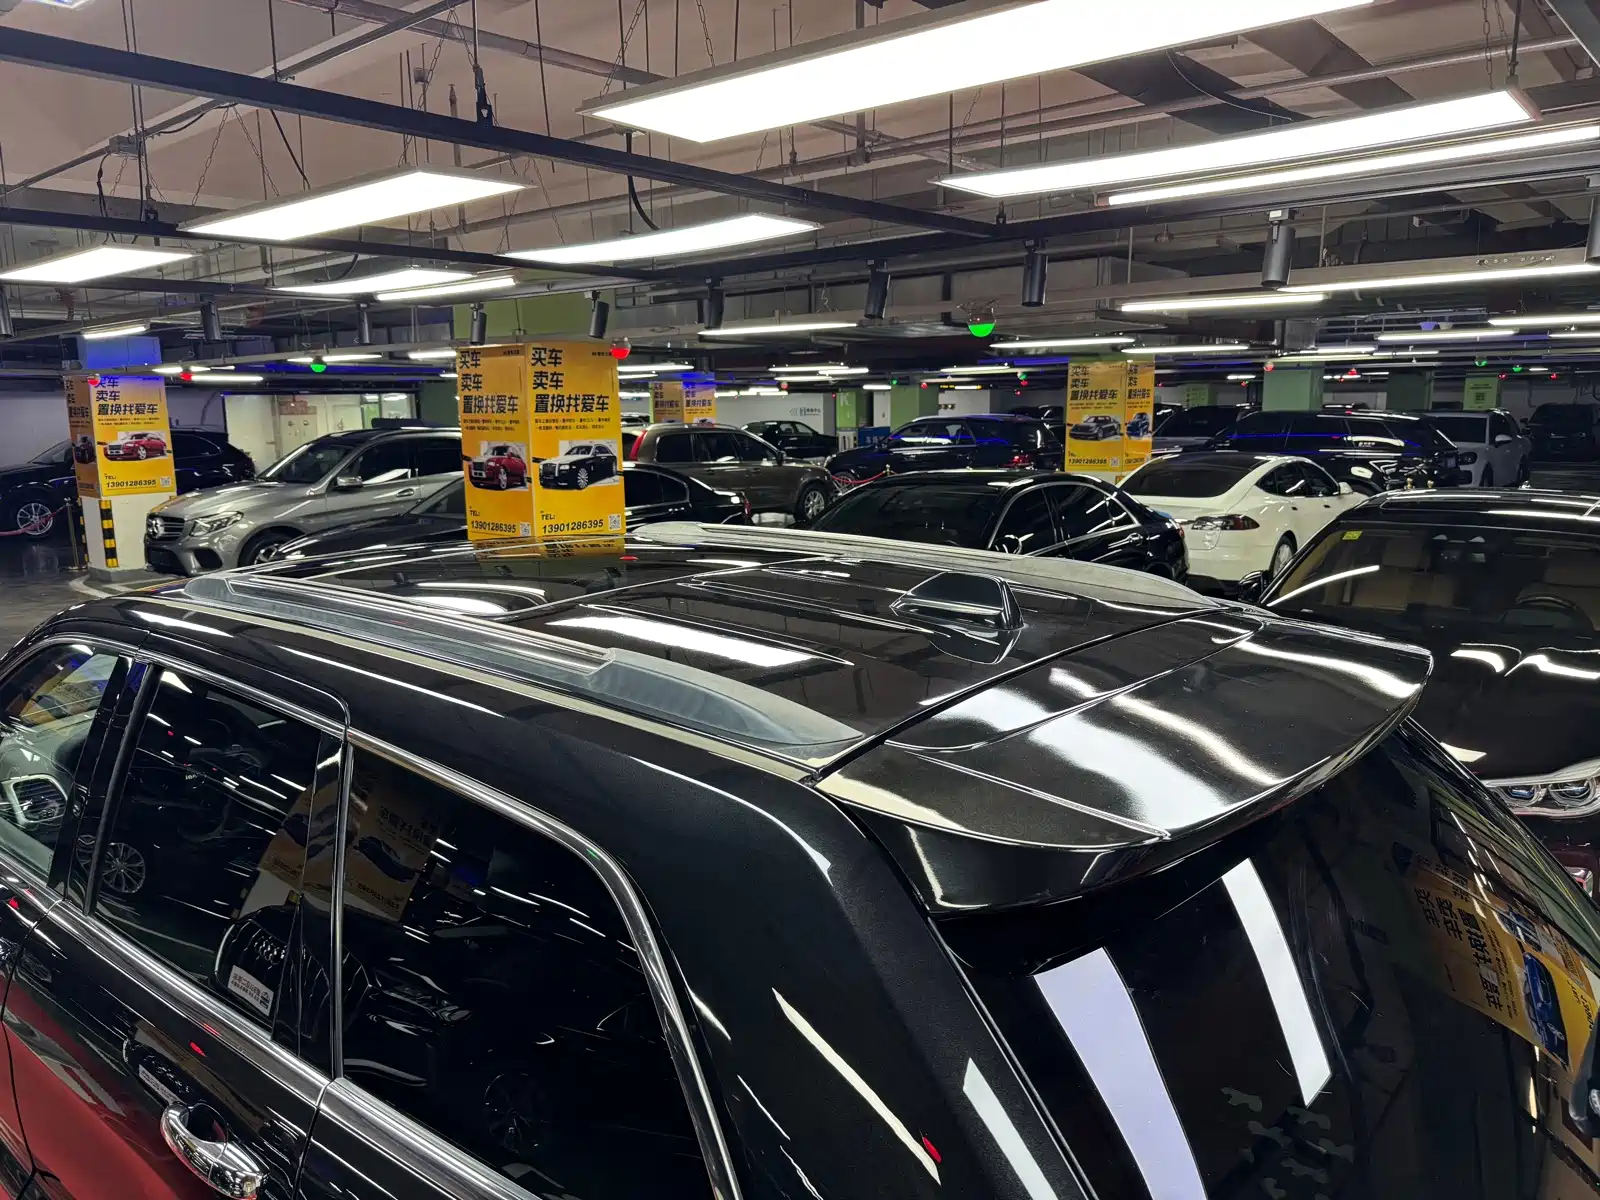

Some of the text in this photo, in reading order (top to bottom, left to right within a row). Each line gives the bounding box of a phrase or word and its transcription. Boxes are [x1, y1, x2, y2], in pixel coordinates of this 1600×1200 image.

[459, 350, 481, 369] 买车
[531, 347, 563, 367] 买车
[461, 373, 482, 392] 卖车
[532, 371, 564, 390] 卖车
[96, 390, 120, 402] 卖车
[463, 395, 519, 414] 置换找爱车
[534, 393, 610, 413] 置换找爱车
[97, 403, 158, 416] 置换找爱车
[106, 480, 156, 488] 13901286395
[471, 520, 516, 533] 13901286395
[543, 519, 604, 534] 13901286395
